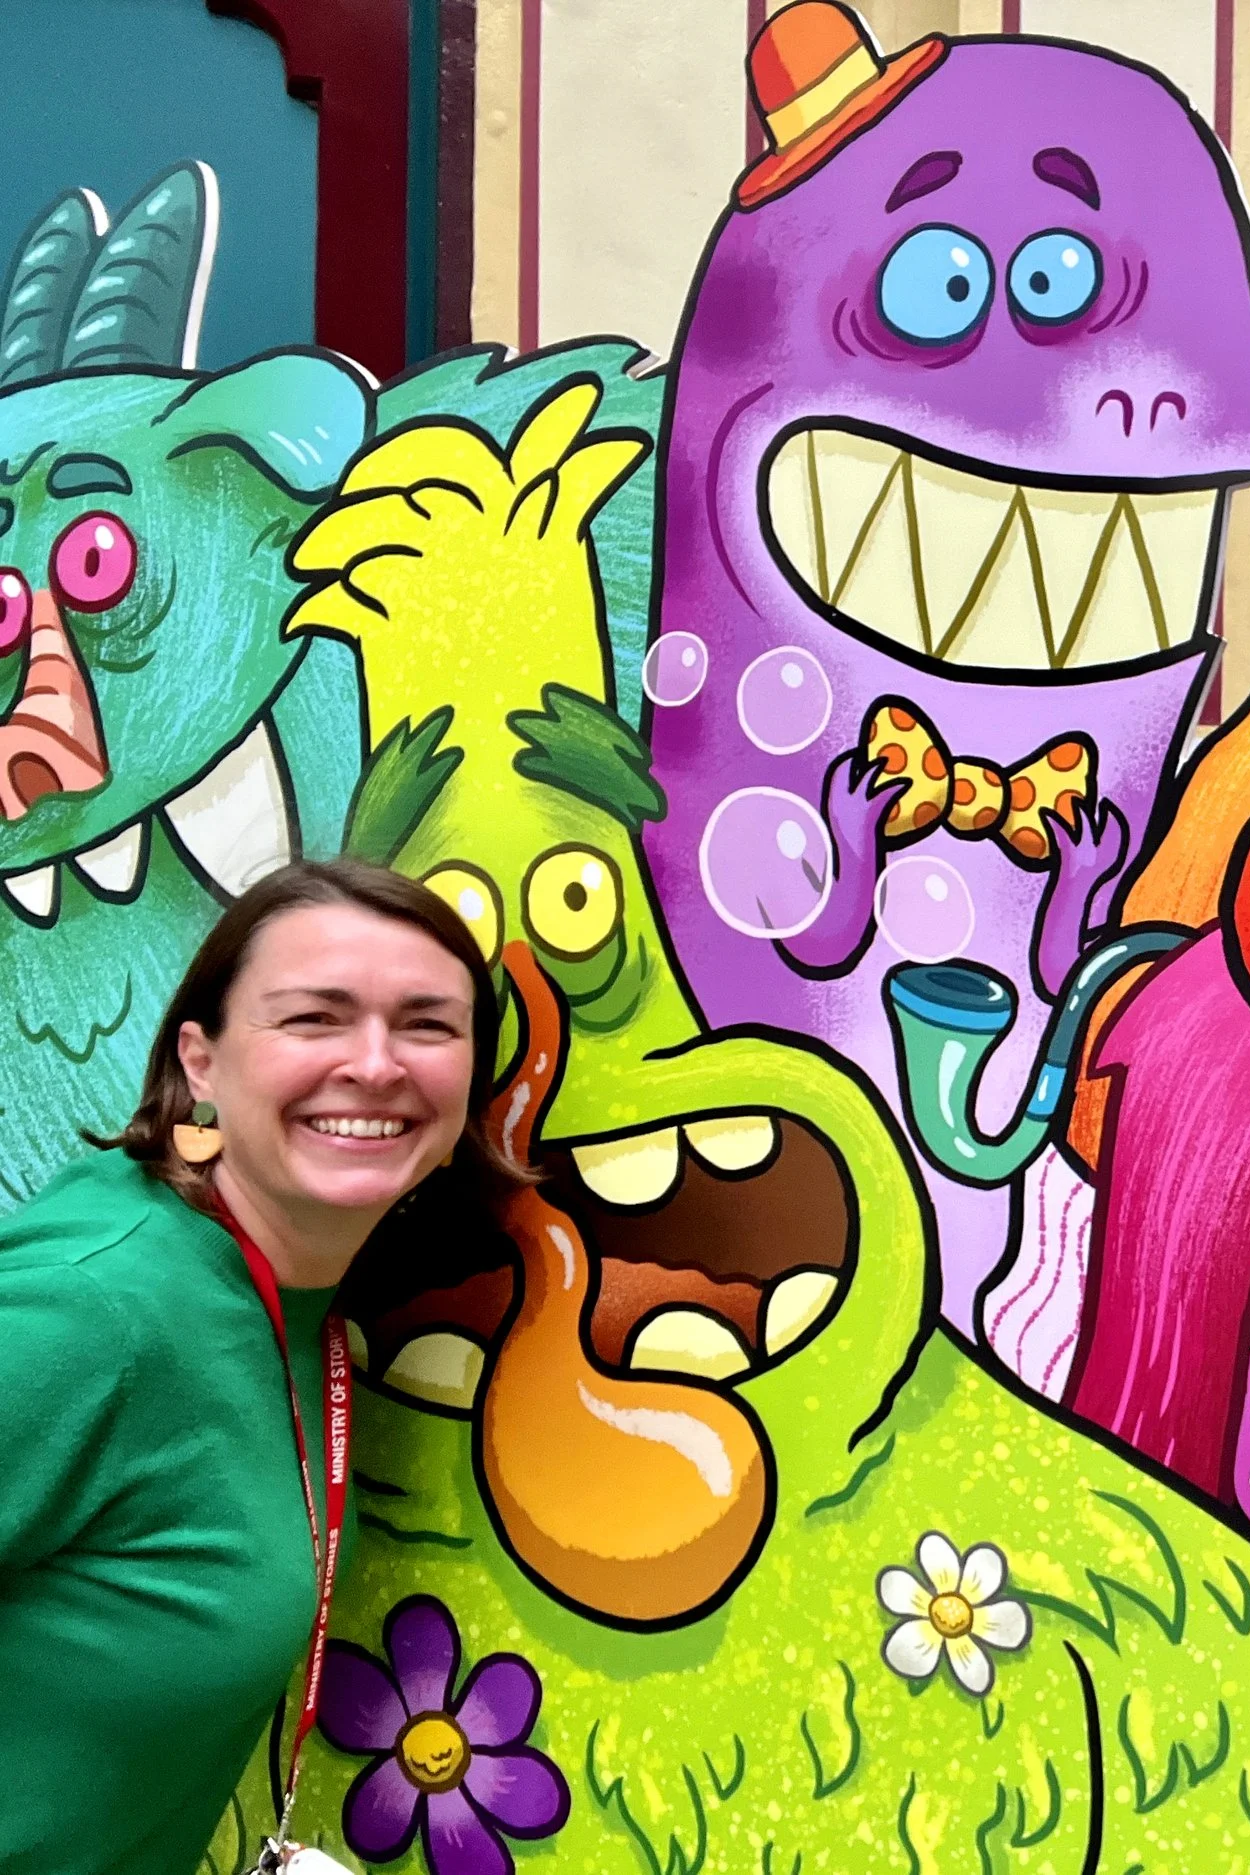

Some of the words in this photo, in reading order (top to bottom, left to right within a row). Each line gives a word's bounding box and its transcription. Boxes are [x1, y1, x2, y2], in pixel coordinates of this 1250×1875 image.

[331, 1381, 346, 1404] OF
[331, 1407, 346, 1484] MINISTRY
[323, 1527, 339, 1599] STORIES
[319, 1602, 328, 1625] OF
[305, 1628, 325, 1711] MINISTRY
